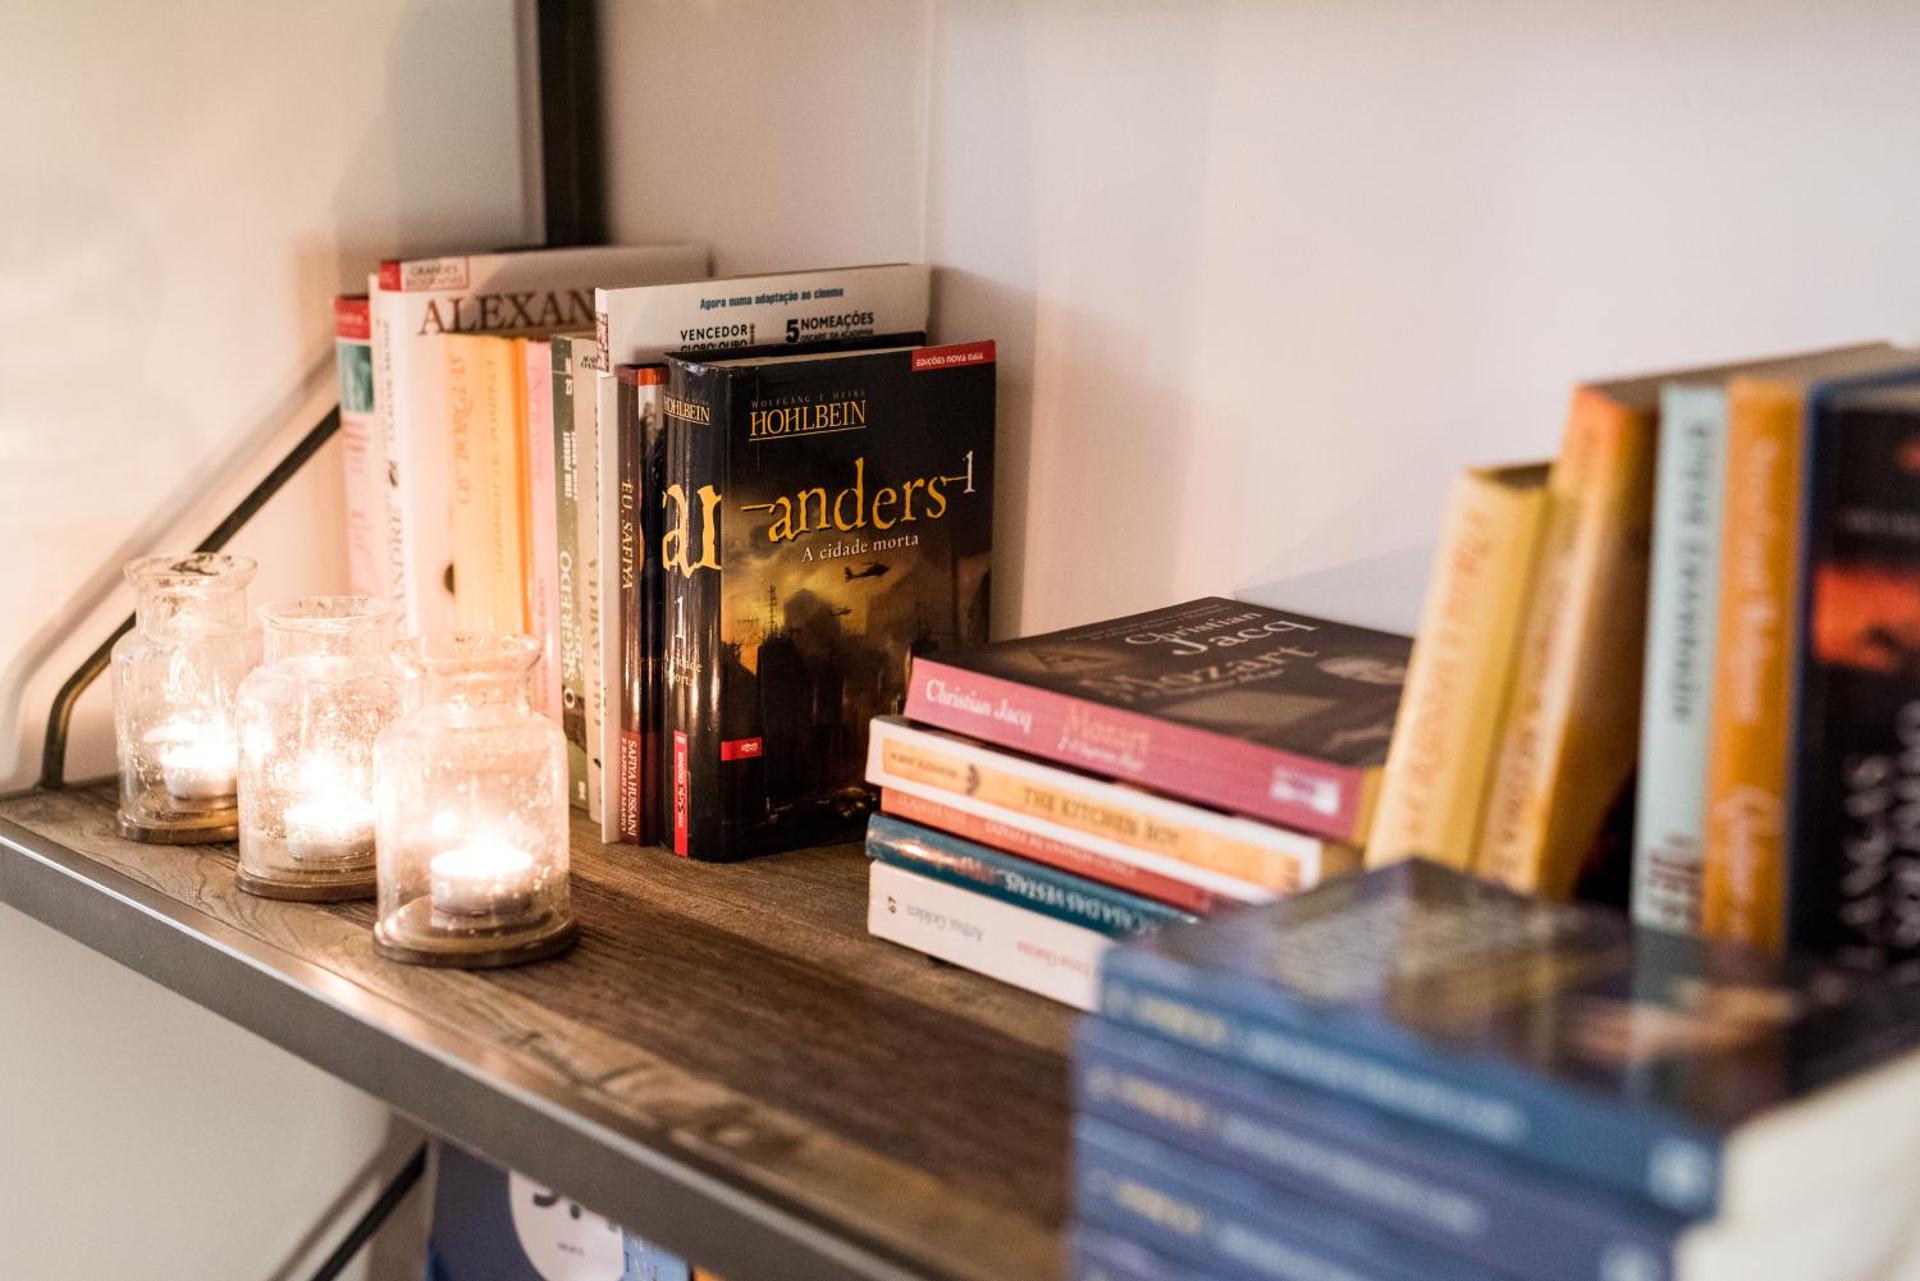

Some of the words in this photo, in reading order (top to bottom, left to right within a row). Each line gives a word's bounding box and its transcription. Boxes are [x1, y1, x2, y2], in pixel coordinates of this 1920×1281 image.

[700, 298, 726, 311] Agora
[729, 297, 751, 307] numa
[755, 290, 798, 305] adaptação
[801, 292, 811, 300] ao
[814, 288, 844, 299] cinema
[680, 323, 748, 341] VENCEDOR
[786, 319, 800, 343] 5
[801, 310, 875, 330] NOMEAÇÕES
[750, 400, 866, 436] HOHLBEIN
[766, 457, 948, 543] anders
[621, 520, 633, 589] SAFIYA
[802, 546, 814, 563] A
[819, 538, 868, 560] cidade
[873, 533, 919, 552] morta
[560, 551, 575, 679] SEGREDO
[1124, 609, 1263, 646] Christian
[1170, 615, 1322, 657] Jacq
[925, 679, 991, 717] Christian
[993, 701, 1034, 733] Jacq
[628, 739, 637, 780] SAFIYA
[628, 781, 637, 836] HUSSAINI
[1022, 785, 1056, 813] THE
[1058, 793, 1141, 837] KITCHEN
[1143, 819, 1181, 848] BOY
